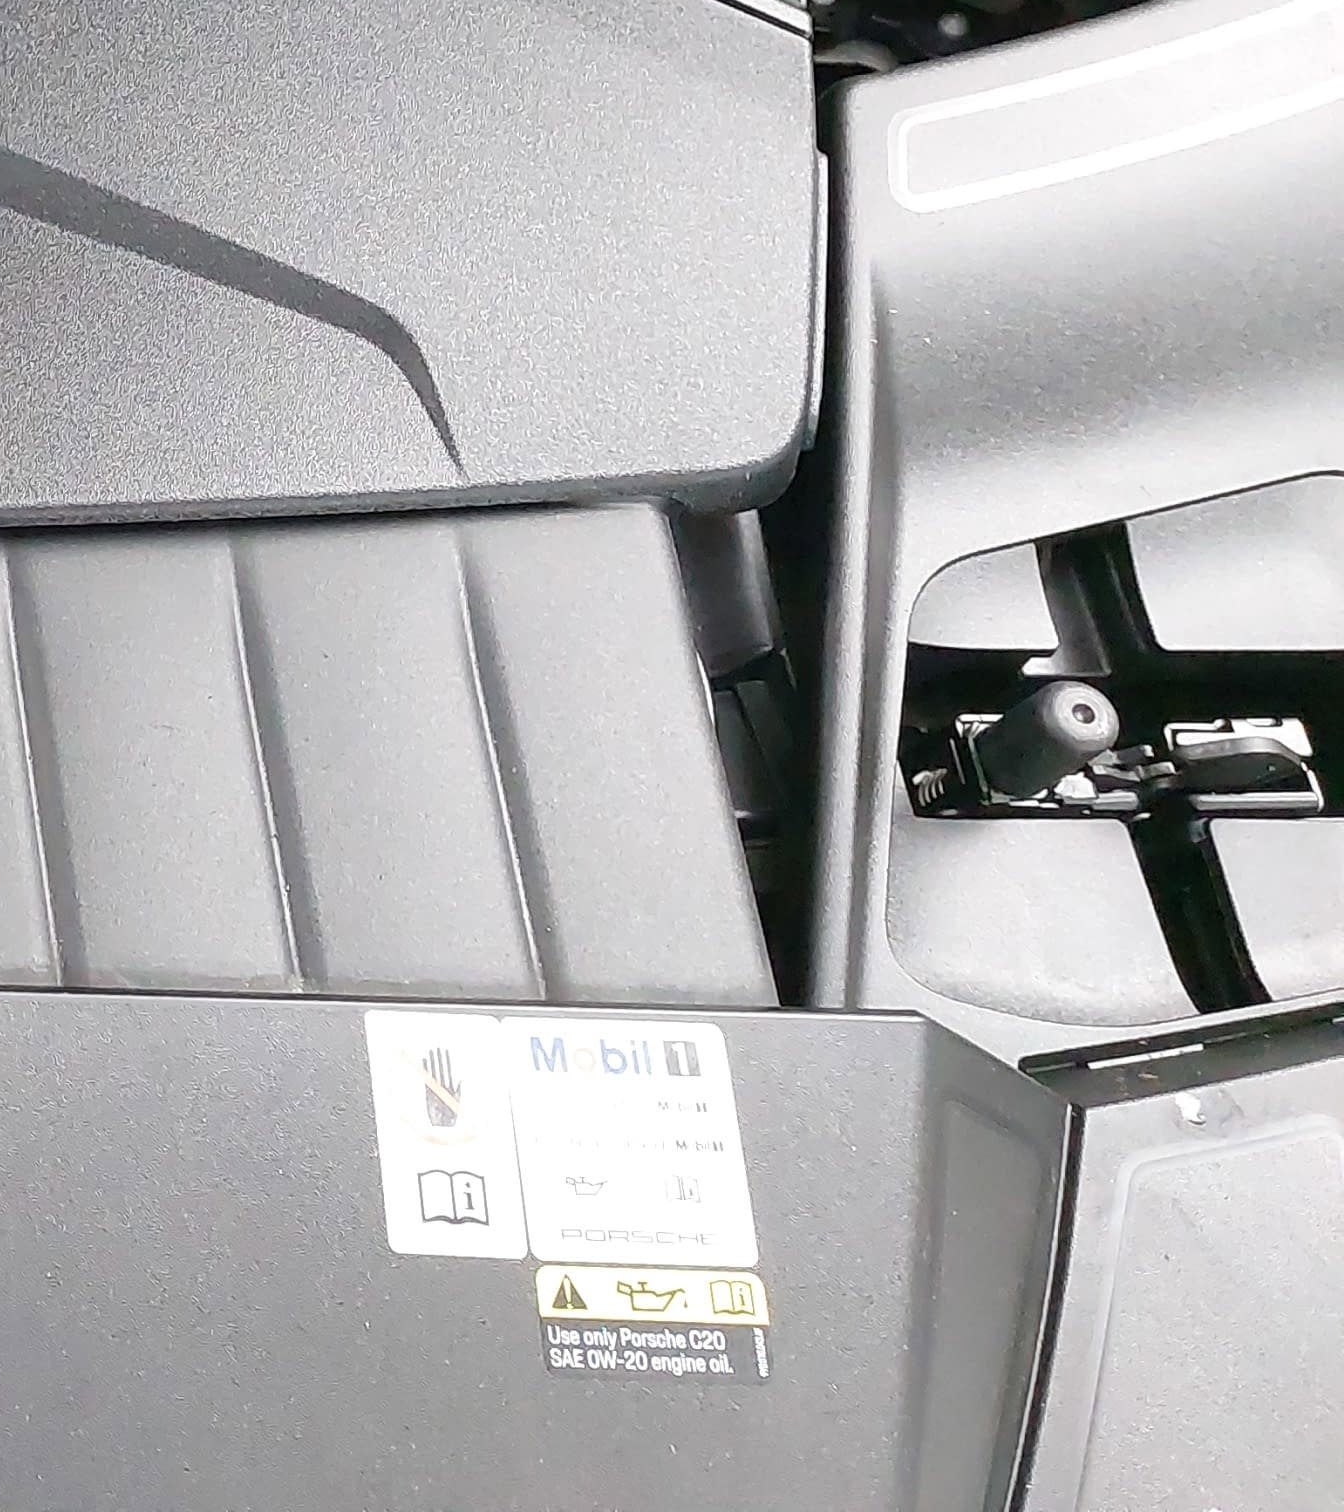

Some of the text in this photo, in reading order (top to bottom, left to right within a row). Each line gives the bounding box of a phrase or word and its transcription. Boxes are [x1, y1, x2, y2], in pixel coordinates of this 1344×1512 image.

[561, 1228, 720, 1246] PORSCHE
[546, 1324, 726, 1351] Use only Porsche C20
[549, 1348, 734, 1376] SAE 0W-20 engine oil.
